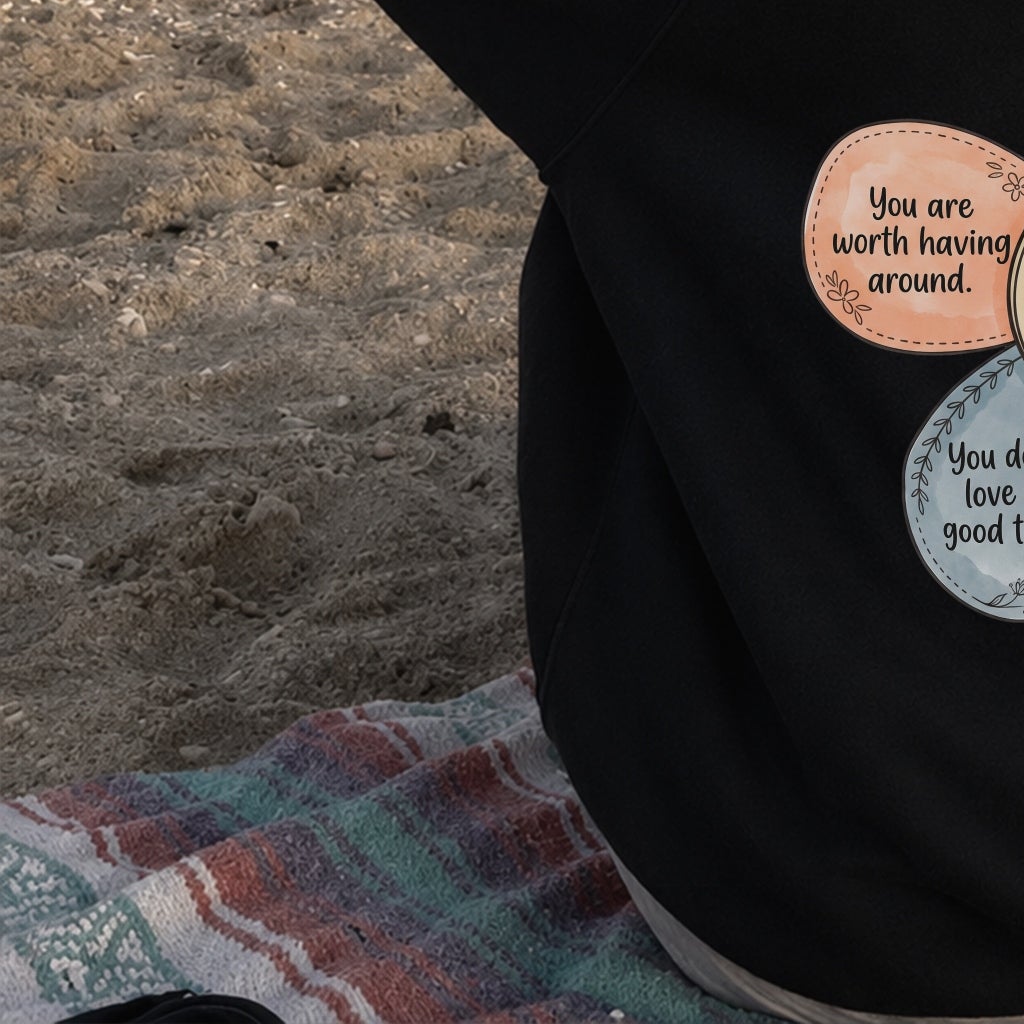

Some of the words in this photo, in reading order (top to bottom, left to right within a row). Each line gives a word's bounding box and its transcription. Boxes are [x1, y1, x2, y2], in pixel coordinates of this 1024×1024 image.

[870, 187, 917, 220] You
[928, 199, 973, 218] are
[833, 226, 908, 256] worth
[920, 226, 1010, 264] having
[869, 263, 971, 293] around.
[949, 442, 995, 475] You
[966, 478, 1016, 508] love
[944, 513, 1003, 551] good
